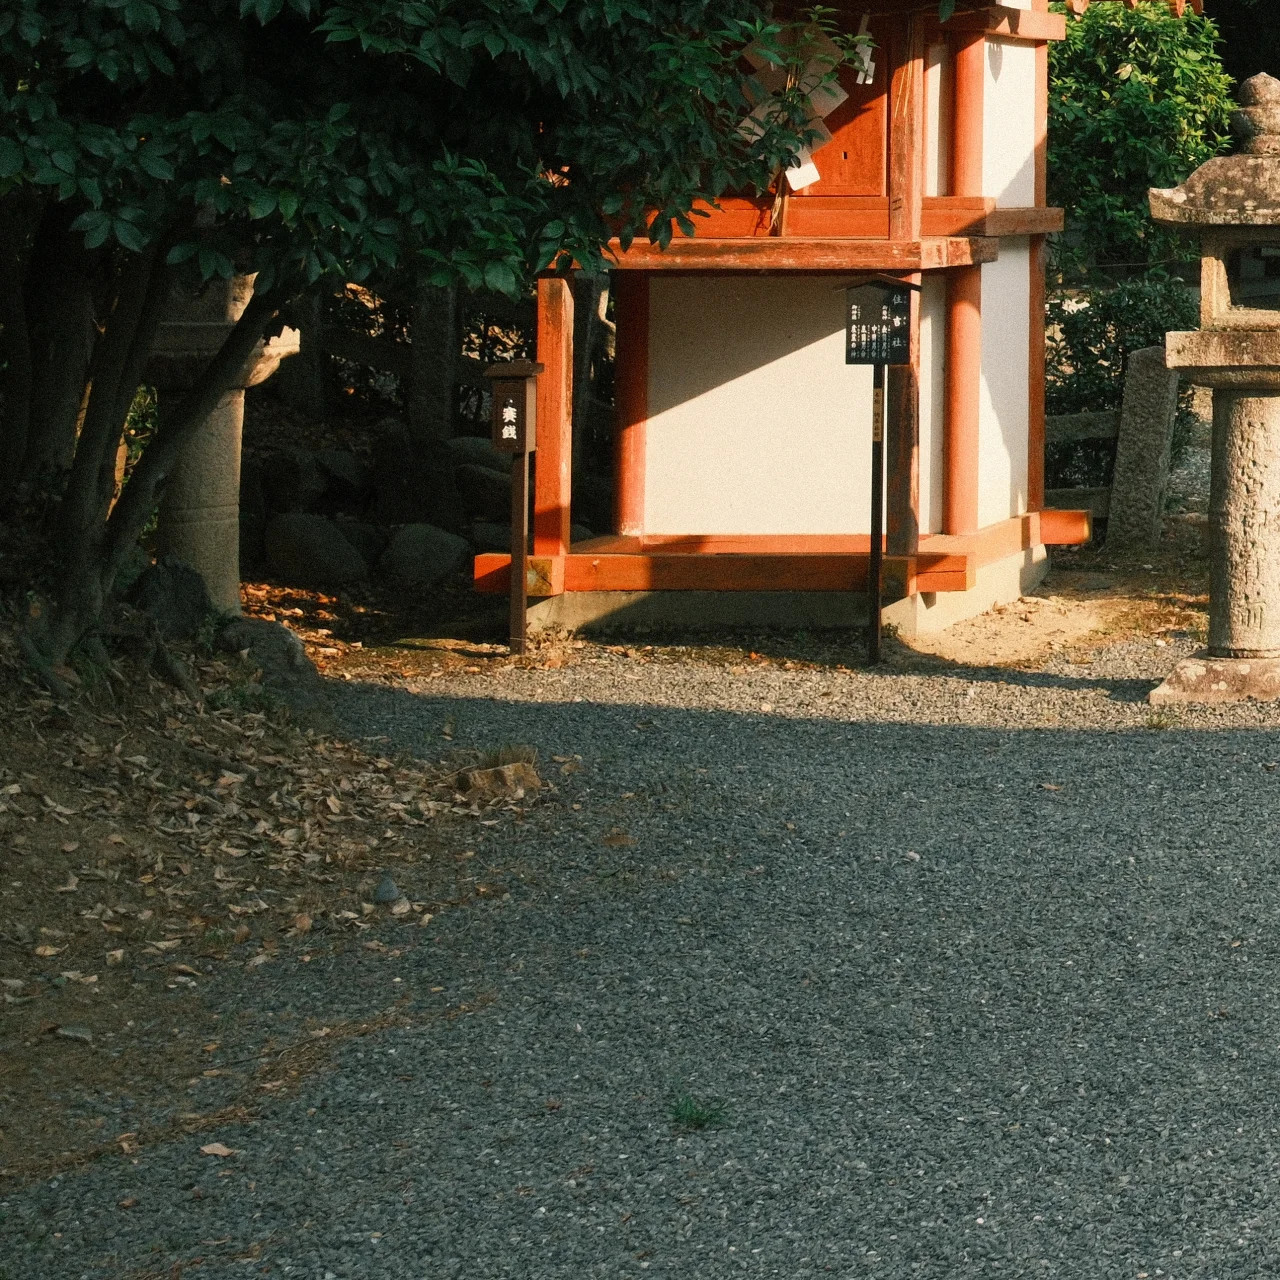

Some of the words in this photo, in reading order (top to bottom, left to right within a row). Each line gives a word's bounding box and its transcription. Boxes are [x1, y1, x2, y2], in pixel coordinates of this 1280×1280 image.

[892, 294, 903, 347] 住吉社
[502, 406, 517, 440] 賽銭
